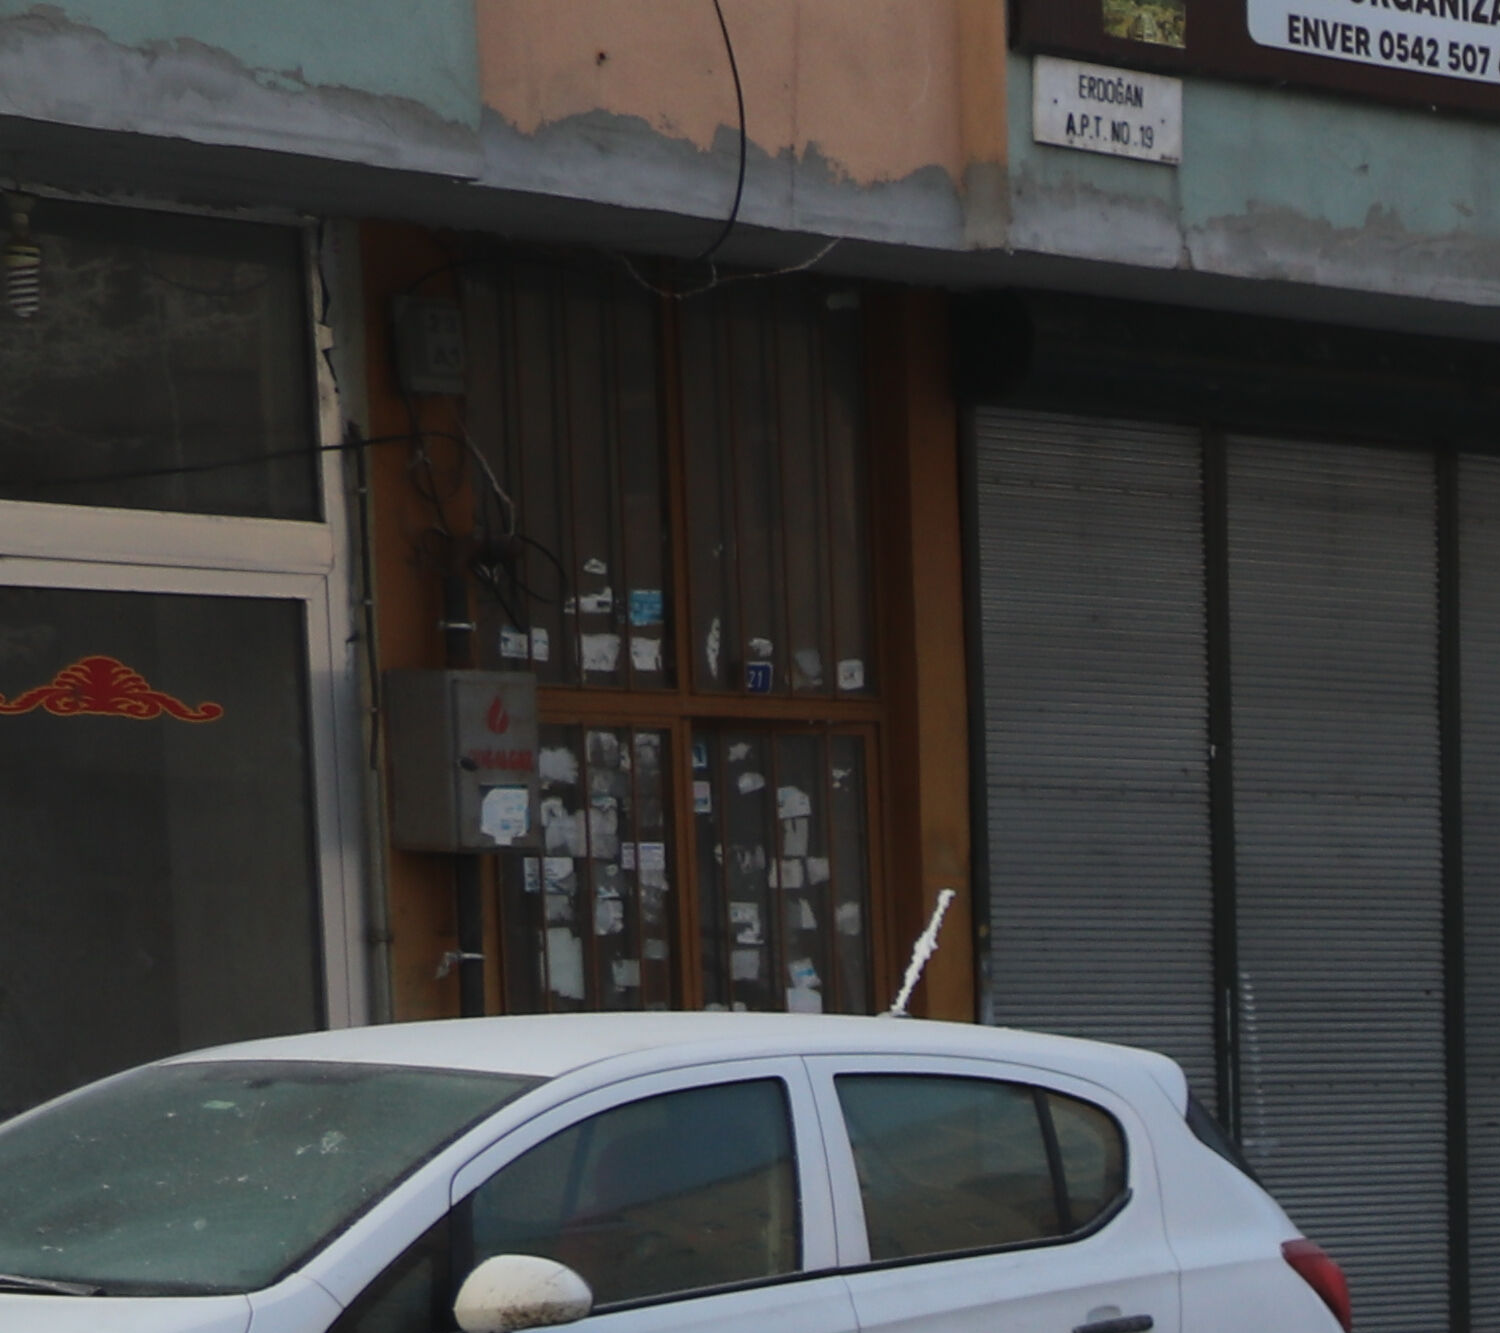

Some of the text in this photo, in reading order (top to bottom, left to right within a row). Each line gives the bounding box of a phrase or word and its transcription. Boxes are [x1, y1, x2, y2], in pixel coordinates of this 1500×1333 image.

[1288, 14, 1371, 57] ENVER
[1379, 30, 1440, 68] 0542
[1448, 42, 1490, 75] 507
[1078, 74, 1144, 108] ERDOĞAN
